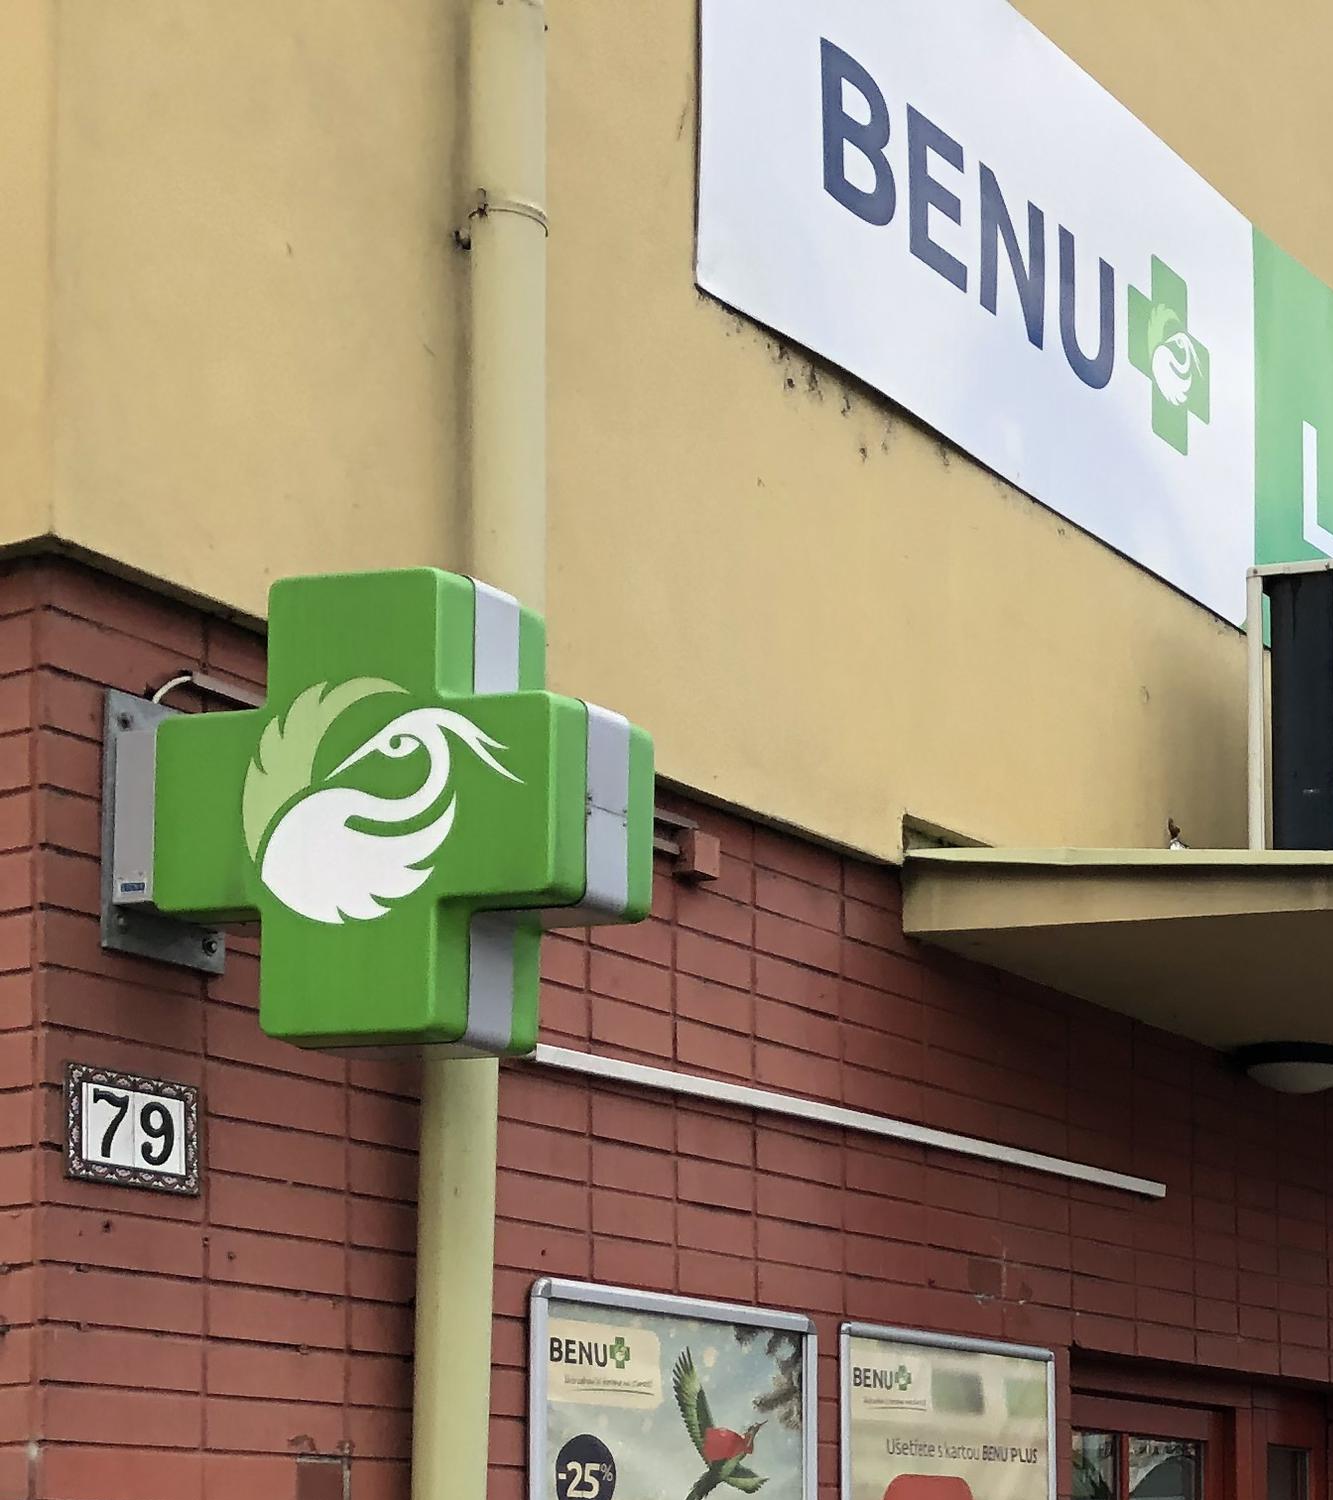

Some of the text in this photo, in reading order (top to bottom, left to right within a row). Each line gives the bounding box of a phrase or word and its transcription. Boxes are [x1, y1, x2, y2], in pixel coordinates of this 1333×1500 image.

[820, 36, 1115, 390] BENU
[93, 1088, 175, 1166] 79
[550, 1337, 608, 1368] BENU
[853, 1367, 893, 1391] BENU
[944, 1441, 980, 1461] kartou
[982, 1445, 1008, 1462] BENU
[1010, 1447, 1038, 1464] PLUS
